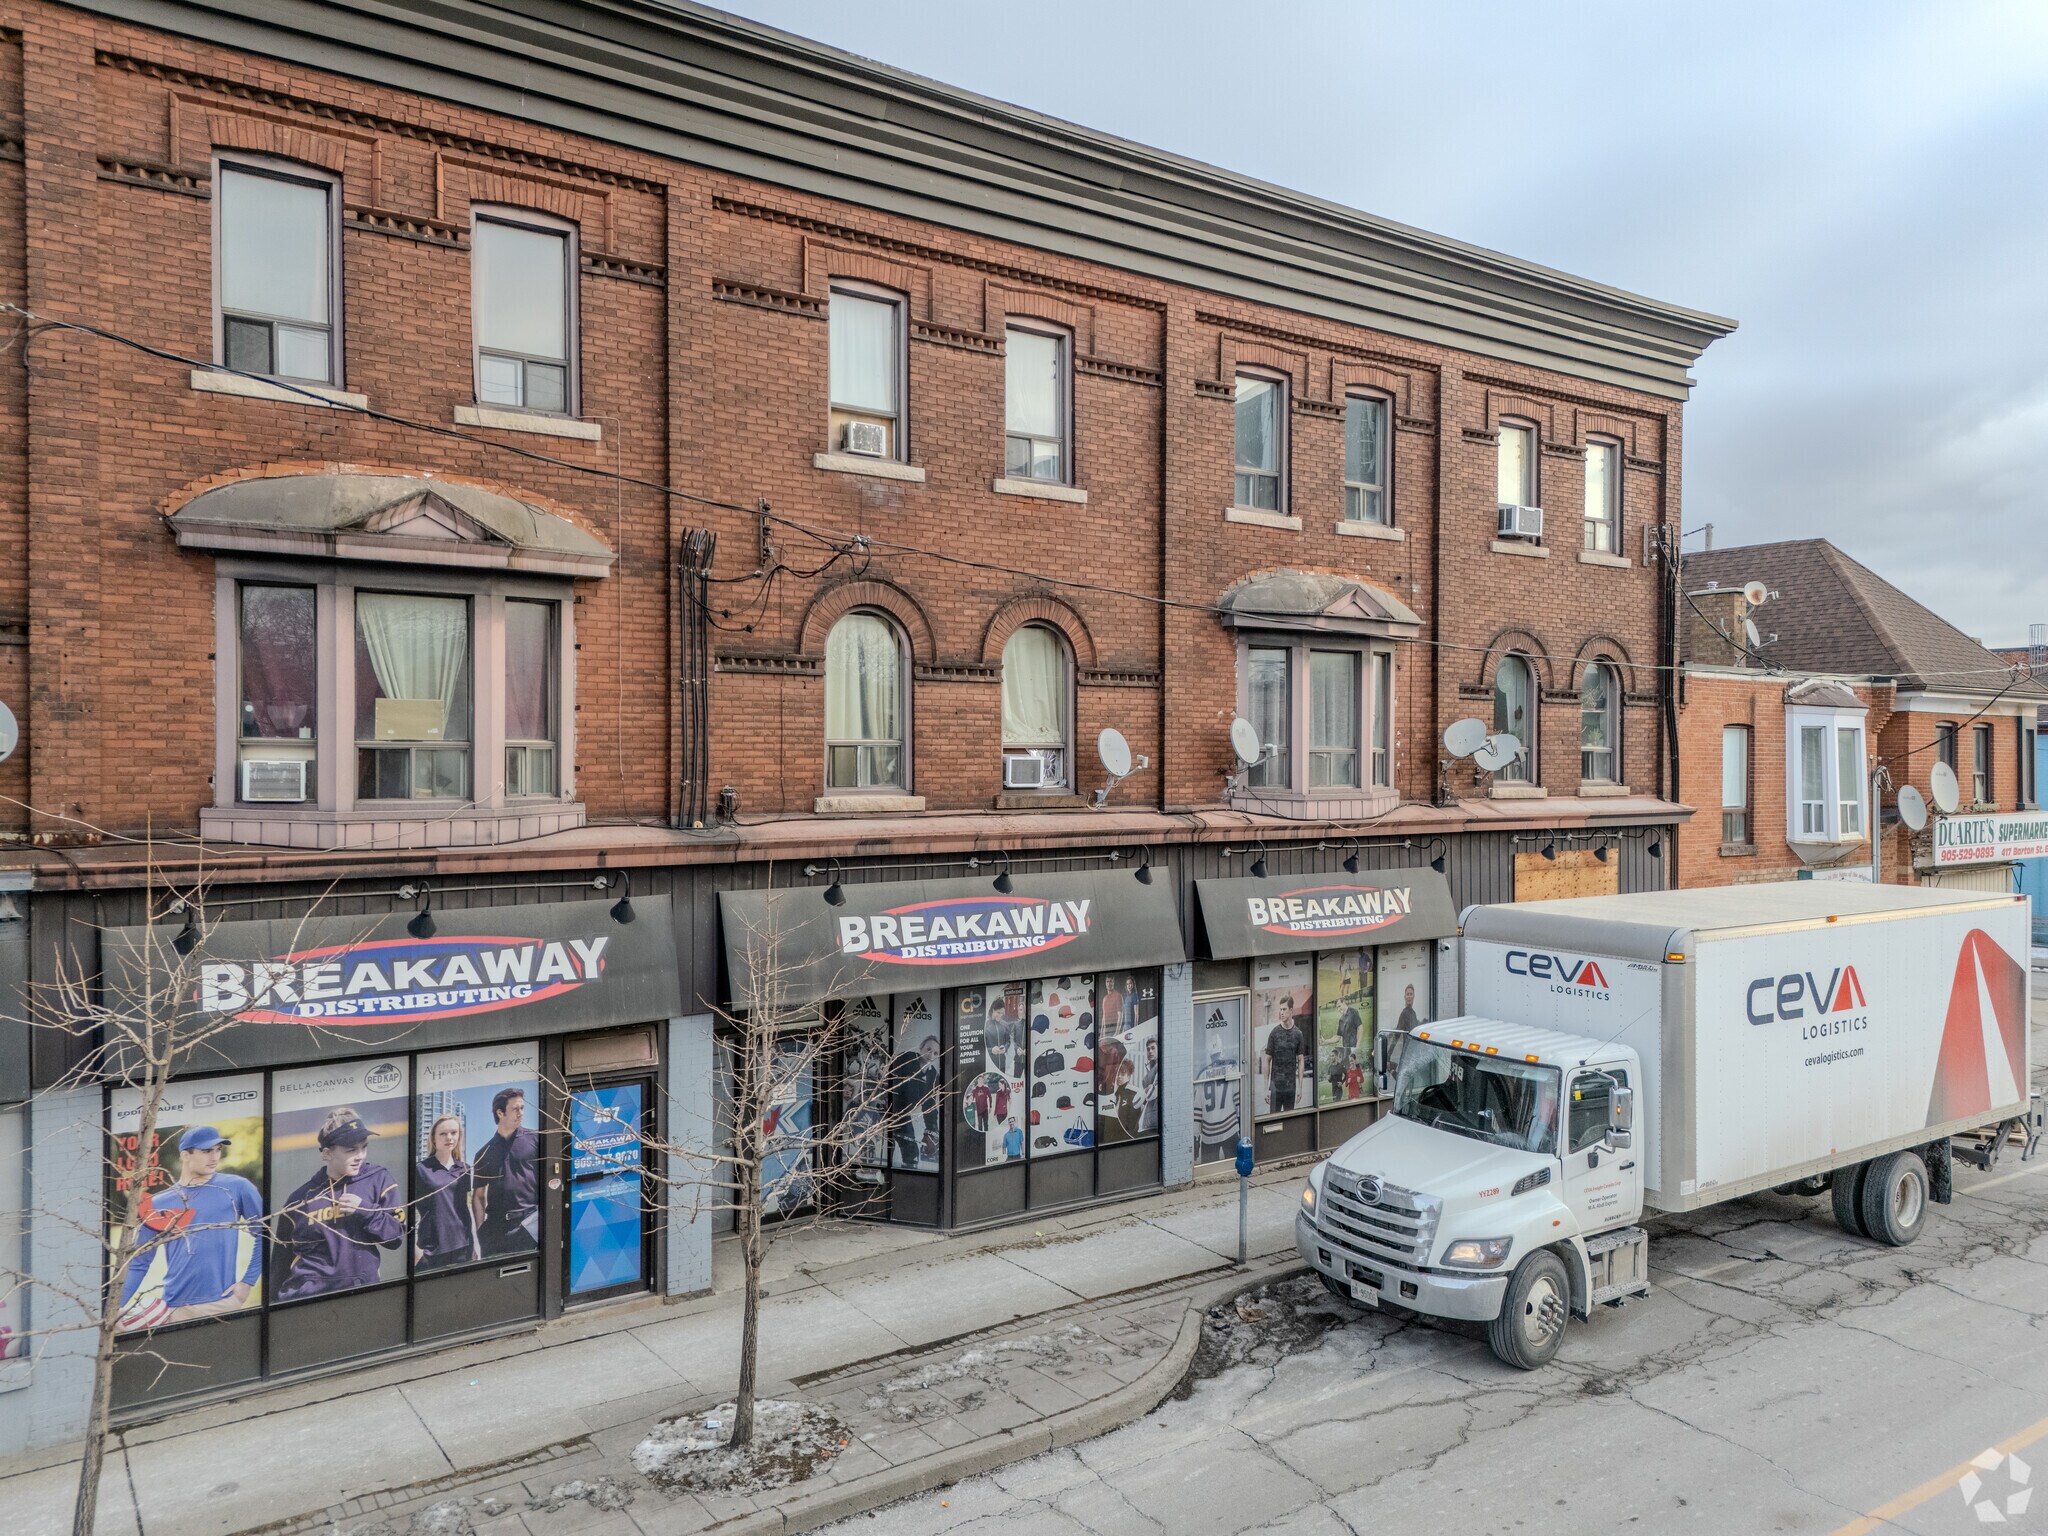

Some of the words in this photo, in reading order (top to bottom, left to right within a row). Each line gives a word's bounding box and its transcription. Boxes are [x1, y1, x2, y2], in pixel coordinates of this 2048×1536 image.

[1938, 818, 1994, 846] DUARTE'S
[1941, 846, 1994, 862] 905-529-0893
[1247, 887, 1411, 926] BREAKAWAY
[839, 900, 1091, 953] BREAKAWAY
[1290, 915, 1385, 931] DISTRIBUTING
[901, 935, 1046, 959] DISTRIBUTING
[201, 937, 608, 1013] BREAKAWAY
[299, 984, 533, 1017] DISTRIBUTING
[1550, 985, 1610, 1001] LOGISTICS
[853, 1008, 881, 1018] adidas
[903, 1011, 932, 1021] adidas
[1206, 1019, 1228, 1029] adidas
[1803, 1016, 1867, 1040] LOGISTICS
[960, 1029, 983, 1038] SOLUTION
[960, 1050, 980, 1058] APPAREL
[960, 1057, 975, 1065] NEEDS
[1805, 1047, 1864, 1067] cevalogistics.com
[424, 1060, 477, 1075] AUTHENTIC
[485, 1056, 533, 1069] FLEXFIT
[367, 1075, 383, 1085] RED
[383, 1073, 399, 1083] KAP
[432, 1065, 483, 1080] HEADWEAR
[1011, 1081, 1024, 1089] TEAM
[215, 1091, 257, 1104] OGIO
[1204, 1080, 1228, 1112] 97
[117, 1109, 144, 1118] EDDI
[155, 1104, 184, 1112] AUER
[117, 1132, 159, 1151] YOR
[117, 1152, 159, 1171] LOO
